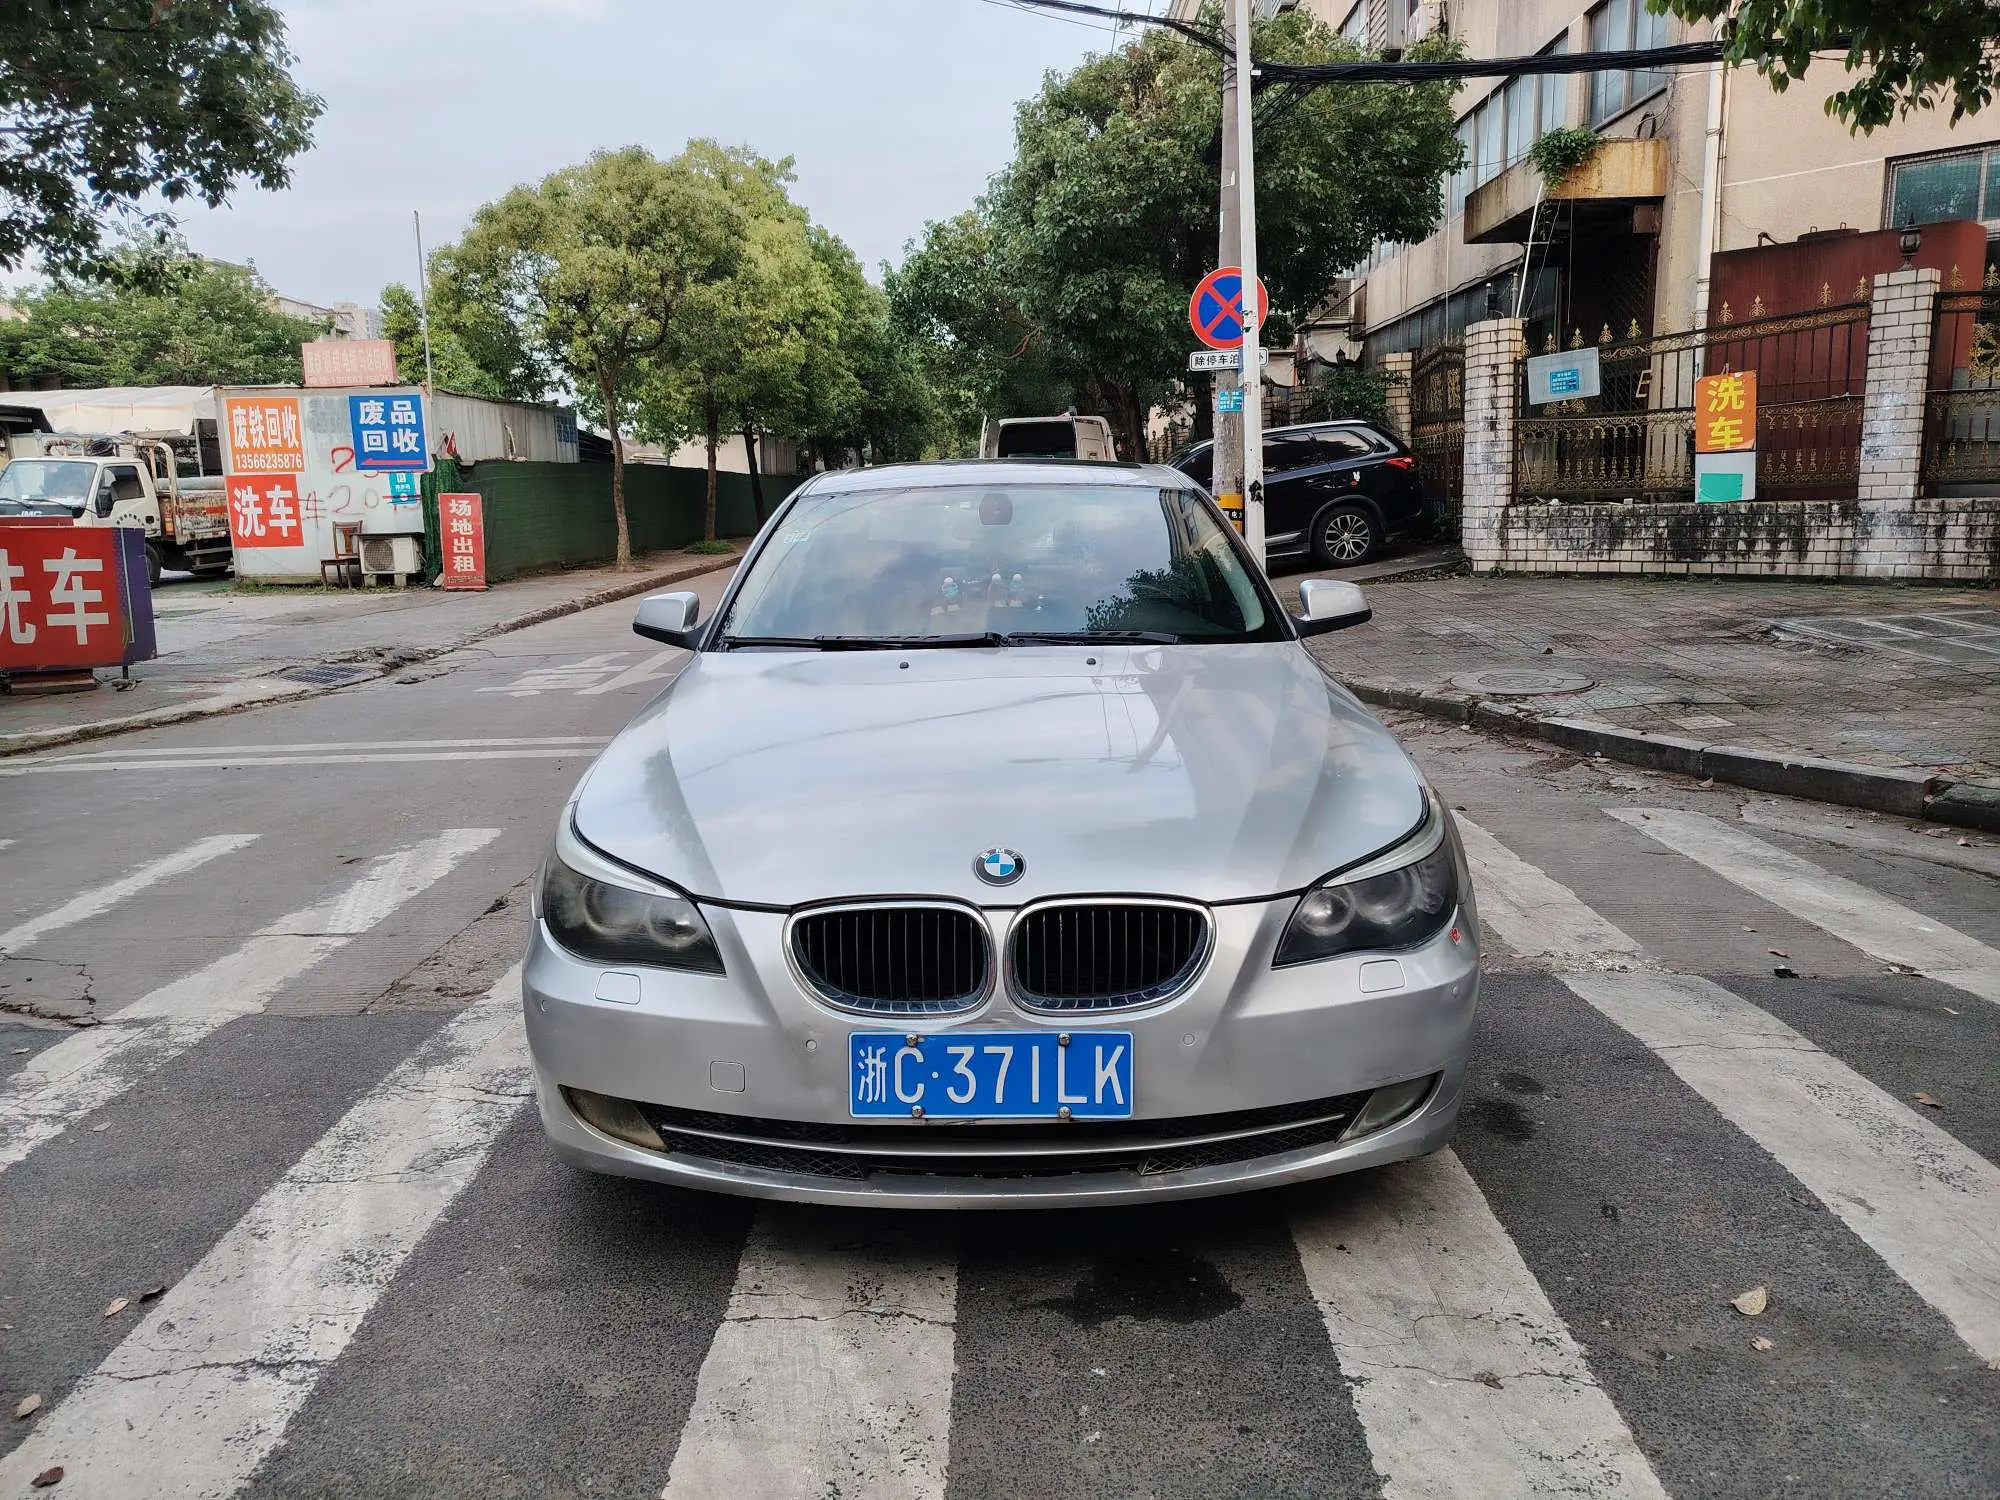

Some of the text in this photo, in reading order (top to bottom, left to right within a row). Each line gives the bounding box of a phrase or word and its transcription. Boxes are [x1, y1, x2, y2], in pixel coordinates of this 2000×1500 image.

[1195, 353, 1263, 367] 除停车泊
[359, 400, 417, 425] 废品
[1707, 377, 1745, 449] 洗车
[232, 405, 300, 449] 废铁回收
[362, 428, 421, 453] 回收
[236, 453, 302, 470] 13566235876
[233, 485, 298, 538] 洗车
[449, 499, 477, 573] 场地出租
[981, 848, 1020, 860] BMW
